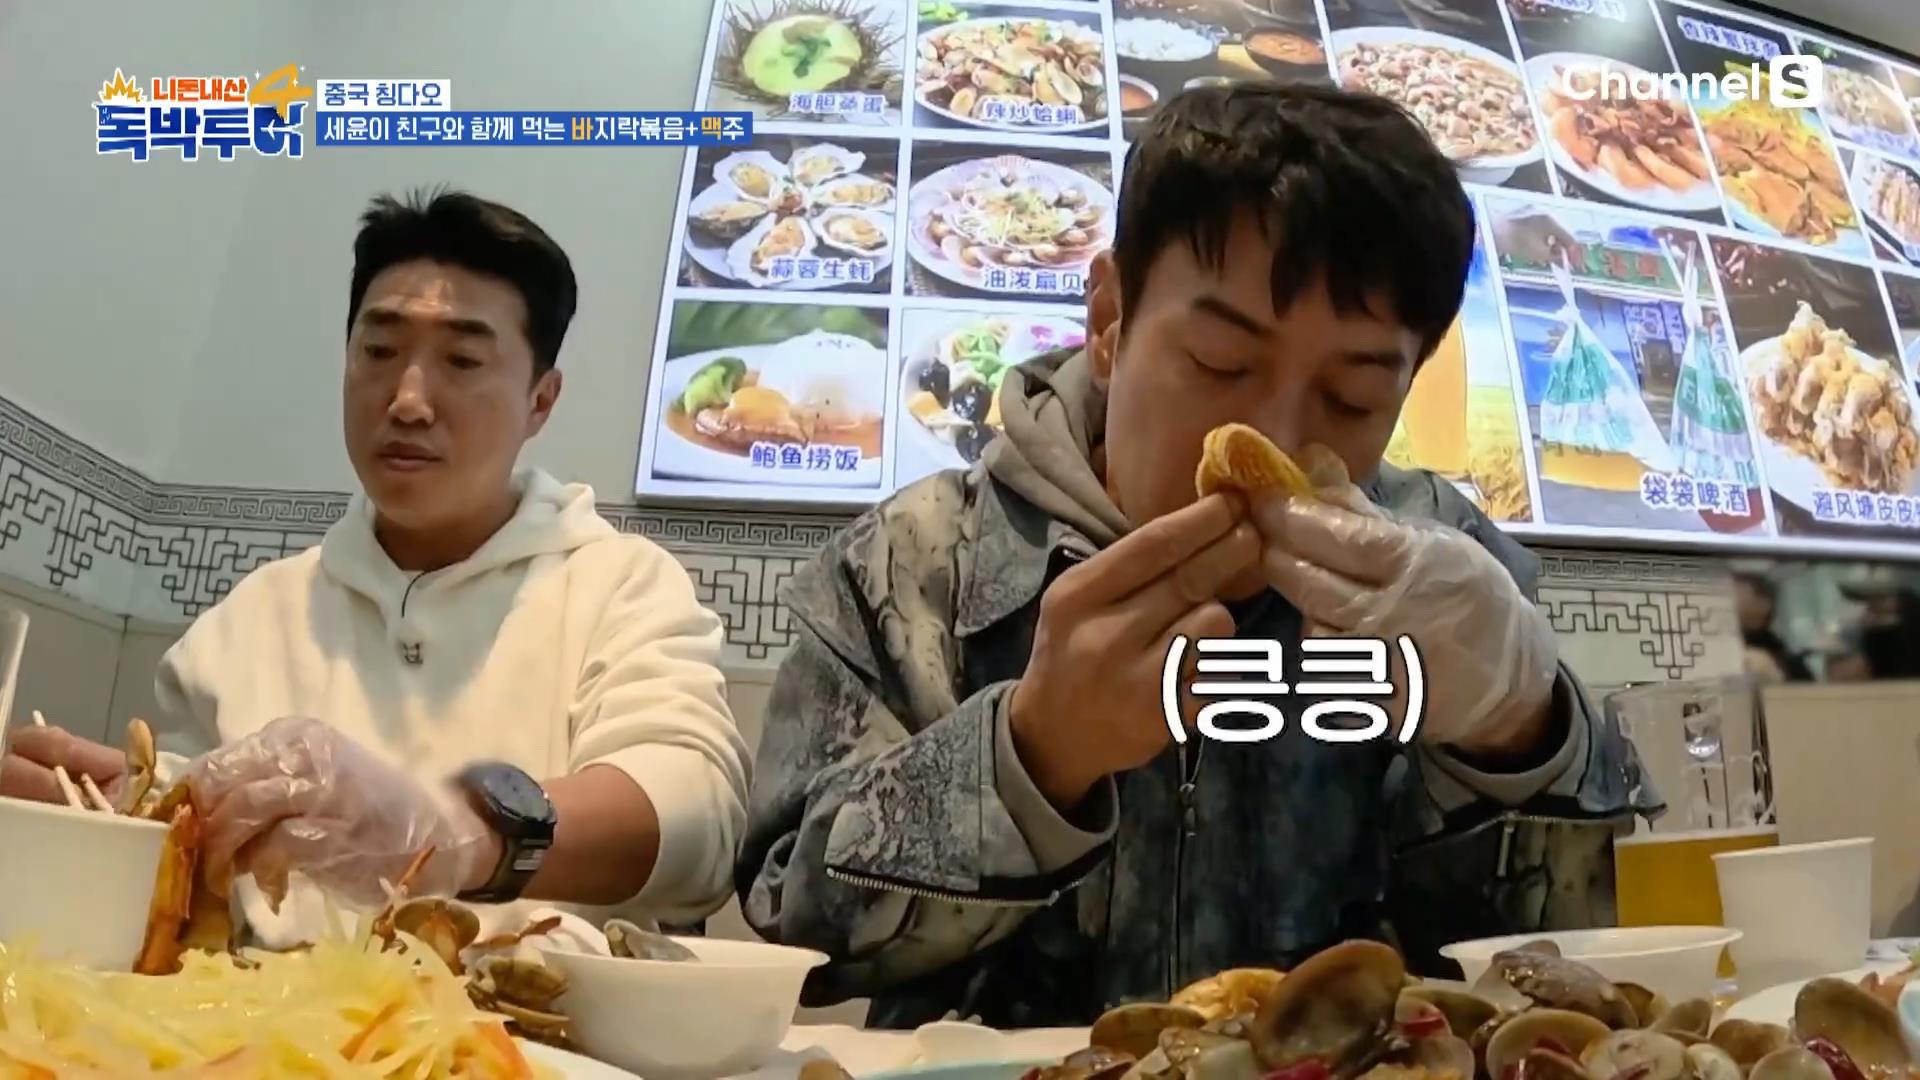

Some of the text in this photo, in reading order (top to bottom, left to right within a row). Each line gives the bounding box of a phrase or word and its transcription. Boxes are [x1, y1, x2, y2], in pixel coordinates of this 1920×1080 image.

[771, 257, 872, 281] 蒜蓉生蚝
[983, 267, 1083, 292] 油泼扇贝
[751, 444, 859, 471] 鲍鱼捞饭
[1642, 473, 1748, 513] 袋袋啤酒
